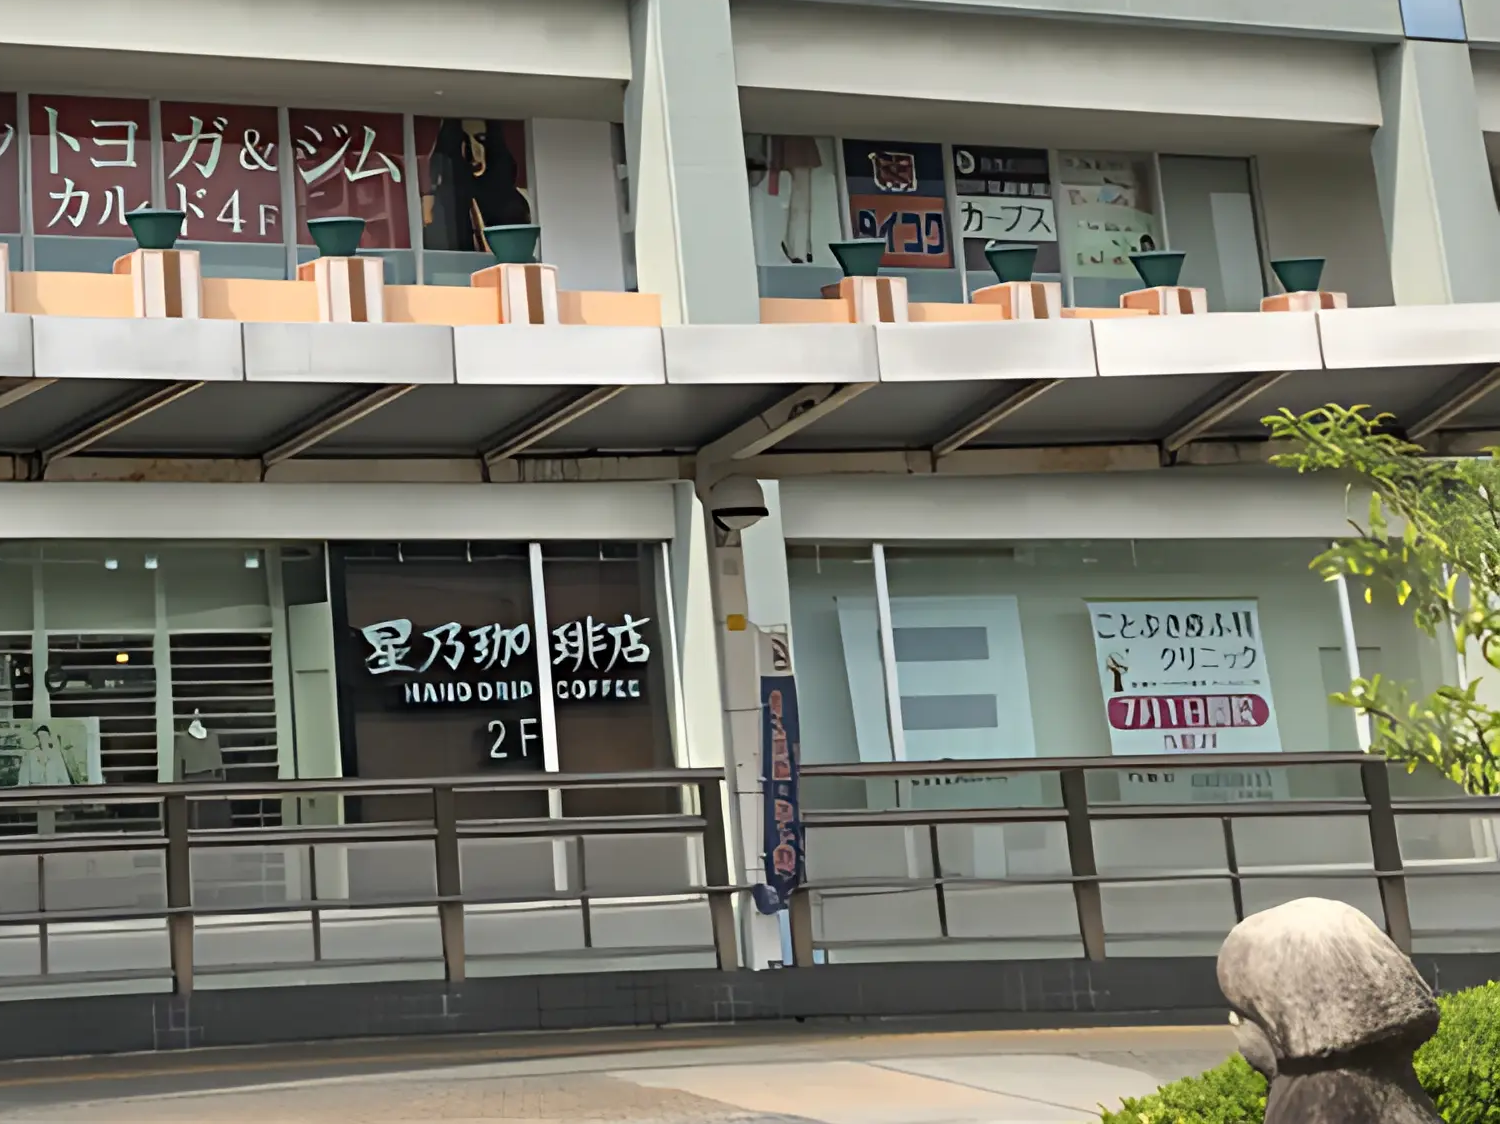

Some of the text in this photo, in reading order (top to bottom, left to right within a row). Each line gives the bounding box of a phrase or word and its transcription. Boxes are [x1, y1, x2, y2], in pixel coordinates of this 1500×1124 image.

[361, 614, 650, 674] 星乃珈琲店
[1160, 645, 1257, 672] クリニック
[556, 679, 641, 700] COFFEE
